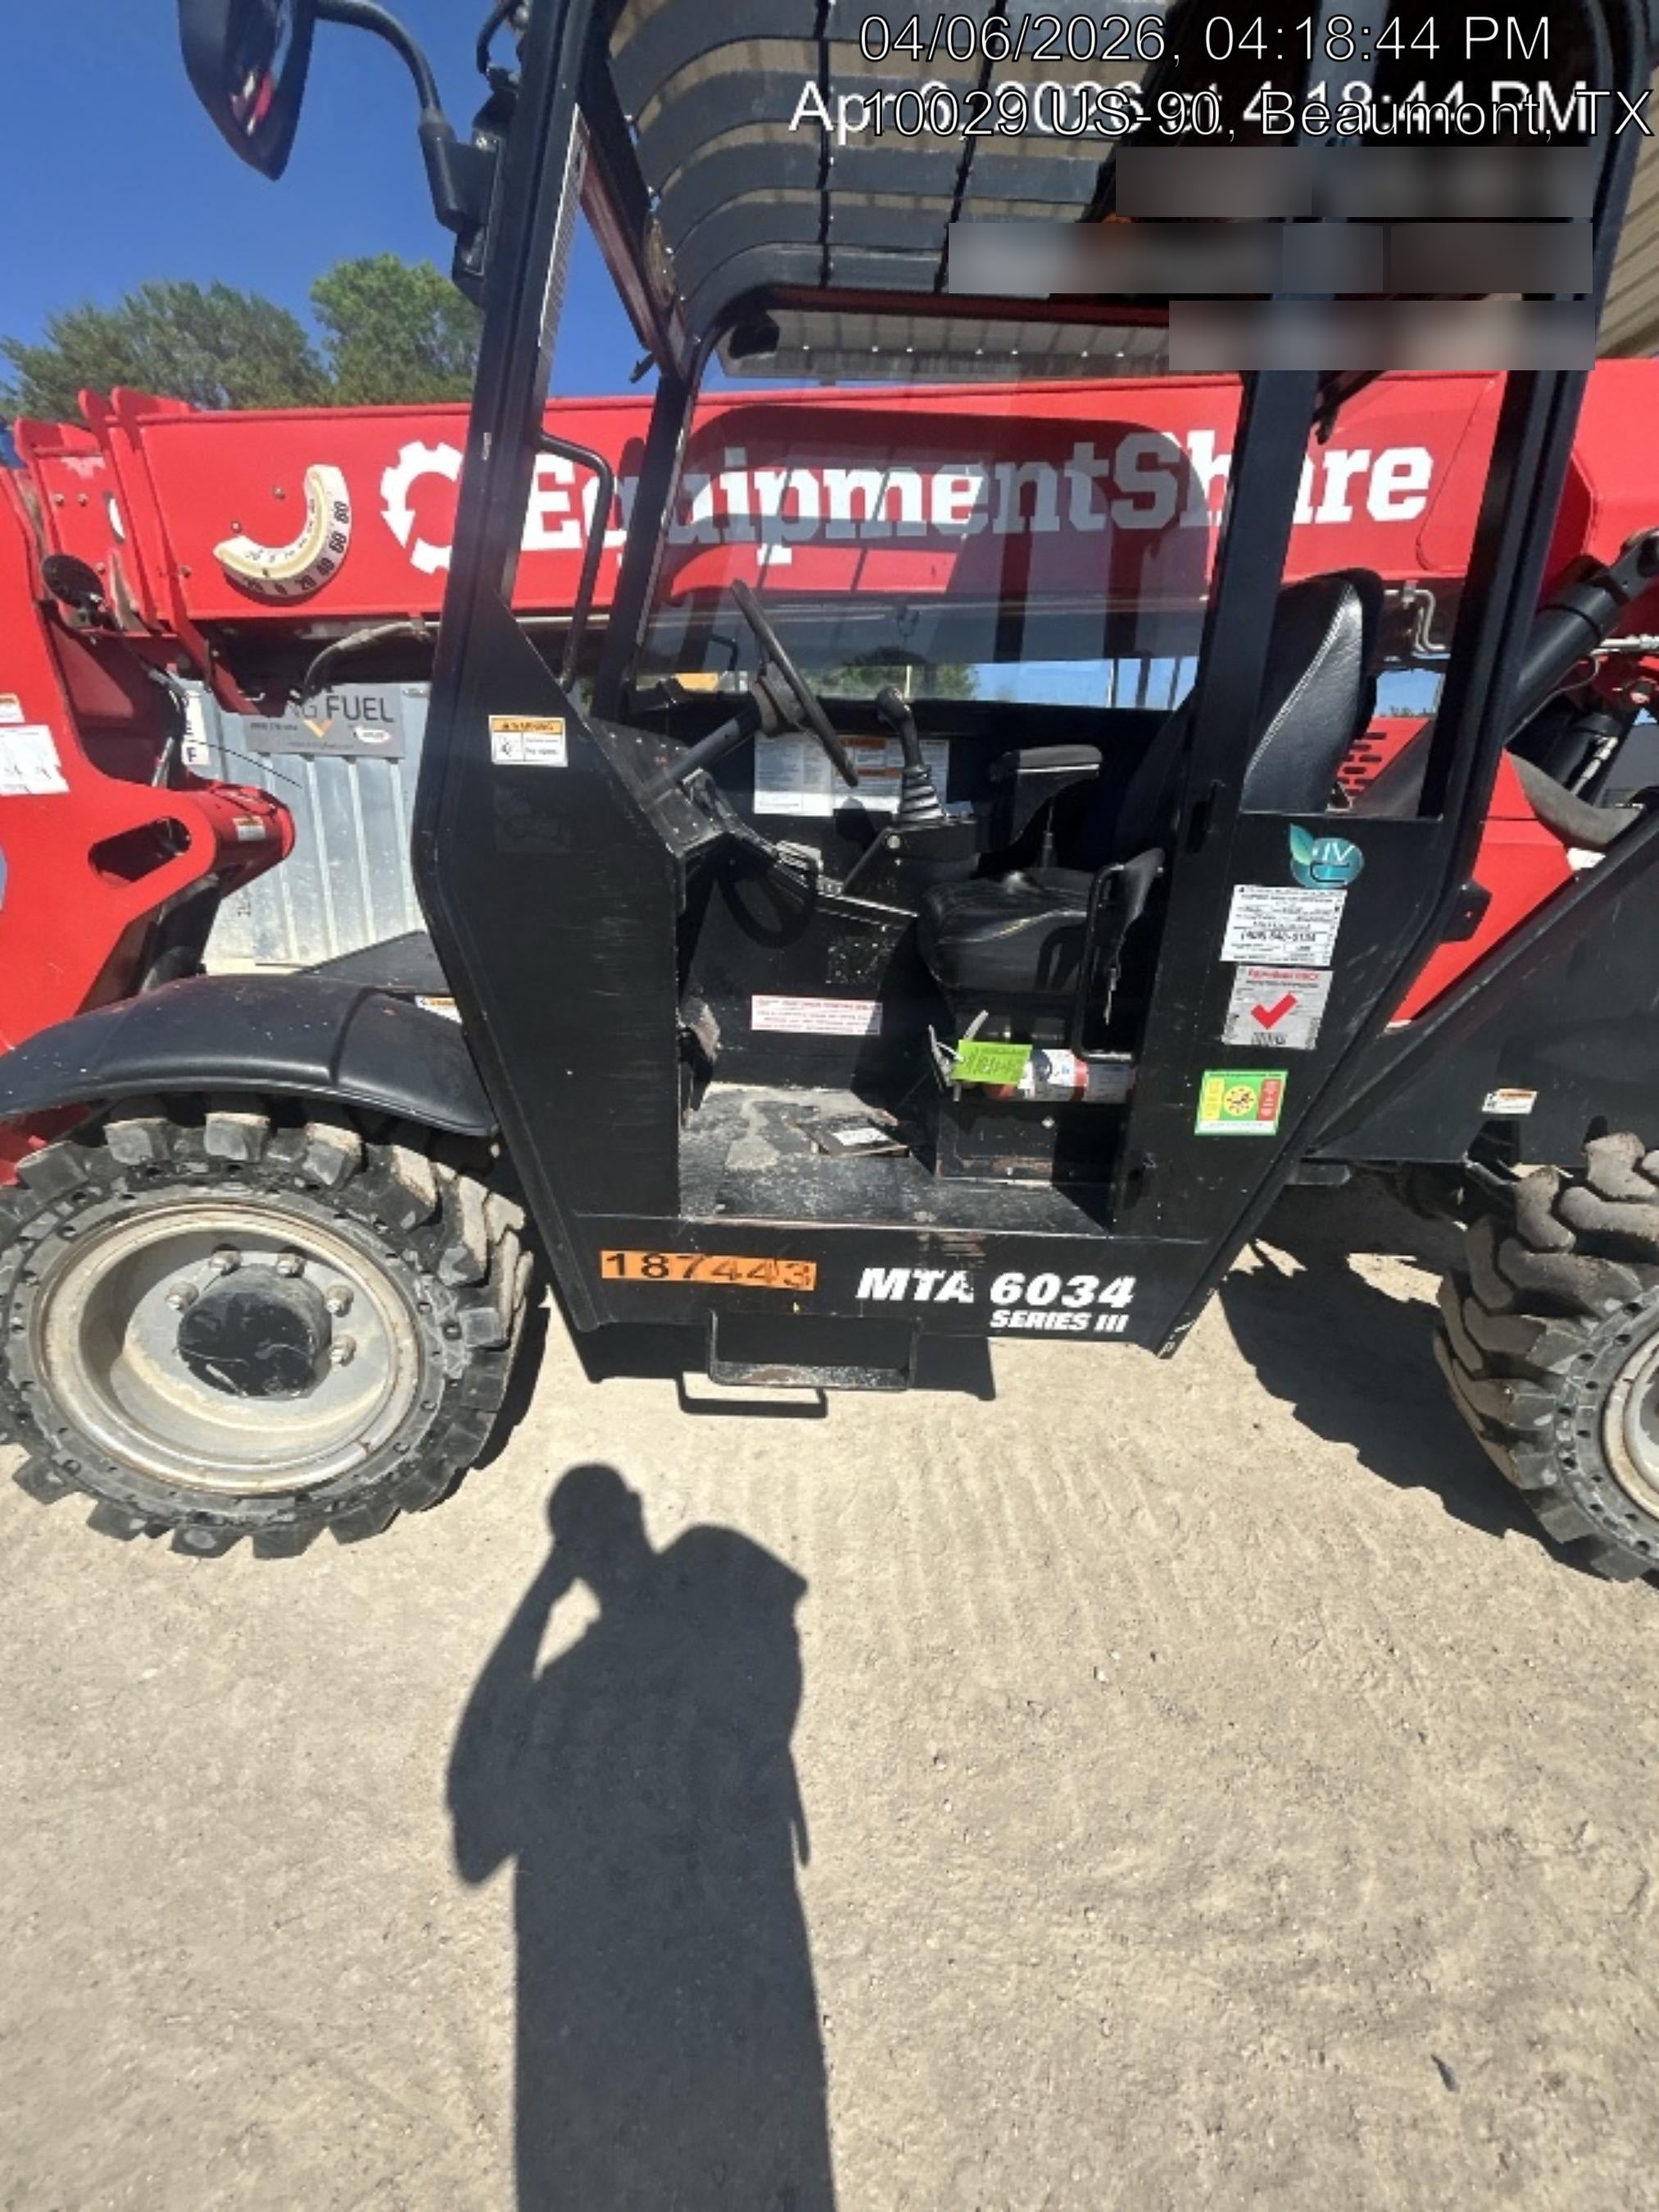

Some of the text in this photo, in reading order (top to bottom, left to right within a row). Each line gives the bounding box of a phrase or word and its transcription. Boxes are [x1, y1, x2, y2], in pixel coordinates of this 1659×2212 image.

[521, 429, 1434, 565] EquipmentShre
[325, 695, 395, 723] FUEL
[605, 1252, 812, 1289] 187443
[855, 1267, 1137, 1308] MTA 6034
[990, 1309, 1130, 1333] SERIES III
